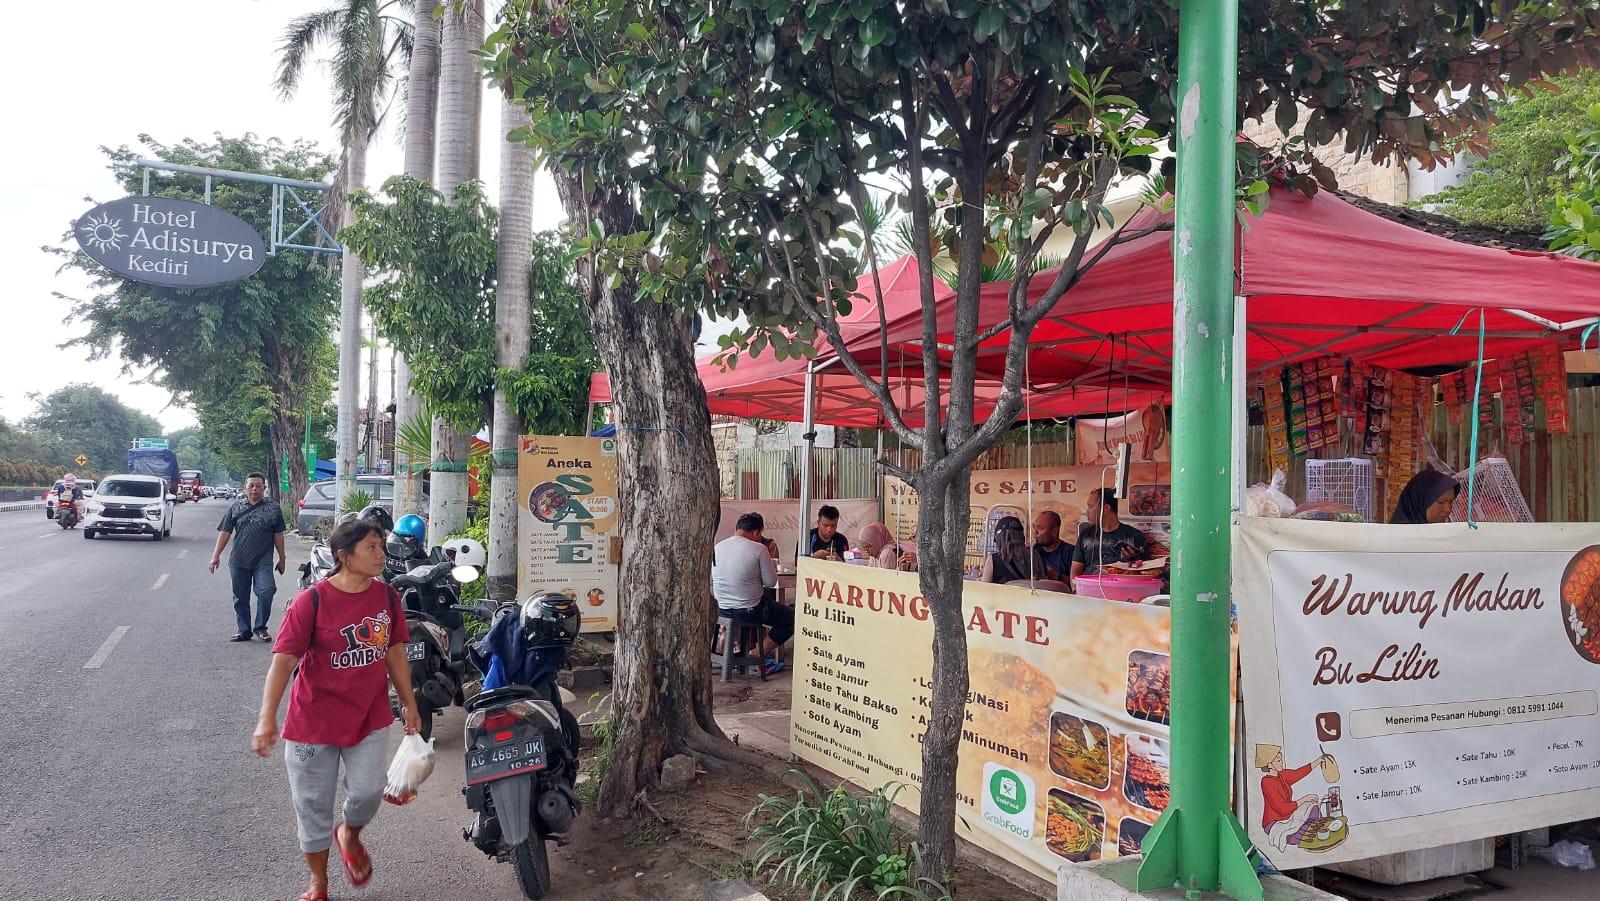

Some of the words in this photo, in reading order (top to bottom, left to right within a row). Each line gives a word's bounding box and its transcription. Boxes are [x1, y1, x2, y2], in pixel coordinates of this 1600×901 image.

[132, 204, 196, 229] Hotel
[129, 227, 254, 263] Adisurya
[128, 254, 189, 276] Kediri
[547, 458, 592, 469] Aneka
[999, 479, 1077, 495] SATE
[553, 473, 595, 564] SATE
[805, 577, 929, 622] WARUNG
[967, 605, 1050, 646] ATE
[1303, 573, 1438, 629] Warung
[1441, 572, 1544, 618] Makan
[803, 602, 819, 618] Bu
[824, 607, 855, 626] Lilin
[340, 624, 362, 651] I
[801, 626, 832, 642] Sedia:
[813, 646, 833, 660] Sate
[835, 653, 865, 670] Ayam
[1313, 646, 1354, 686] Bu
[1356, 642, 1440, 684] Lilin
[812, 662, 833, 676] Sate
[836, 670, 869, 688] Jamur
[811, 678, 832, 692] Sate
[836, 686, 859, 703] Tahu
[862, 695, 898, 716] Bakso
[808, 710, 831, 725] Soto
[833, 719, 862, 738] Ayam
[810, 694, 831, 709] Sate
[834, 702, 880, 730] Kambing
[1385, 714, 1429, 725] Menerima
[1430, 712, 1465, 722] Pesanan
[1467, 707, 1500, 718] Hubungi
[1506, 705, 1526, 715] 0812
[1528, 703, 1546, 713] 5991
[1547, 701, 1564, 711] 1044
[471, 754, 485, 768] AG
[525, 741, 540, 757] UK
[793, 733, 823, 753] Tersedia
[823, 749, 832, 757] di
[832, 751, 870, 774] GrabFood
[794, 722, 829, 743] Menerima
[867, 753, 903, 776] Hubungi
[963, 729, 1029, 763] Minuman
[1461, 753, 1478, 762] Sate
[1480, 751, 1498, 760] Tahu
[1503, 748, 1516, 757] 10K
[1574, 739, 1584, 748] 7K
[1359, 766, 1378, 775] Sate
[1380, 764, 1400, 774] Ayam
[1404, 759, 1417, 769] 13K
[1462, 777, 1478, 786] Sate
[1480, 773, 1511, 784] Kambing
[1515, 769, 1528, 779] 25K
[1553, 765, 1569, 774] Soto
[1570, 763, 1588, 774] Ayam
[1362, 792, 1379, 801] Sate
[1381, 789, 1404, 799] Jamur
[1409, 784, 1423, 795] 10K
[983, 811, 1030, 838] GrabFood
